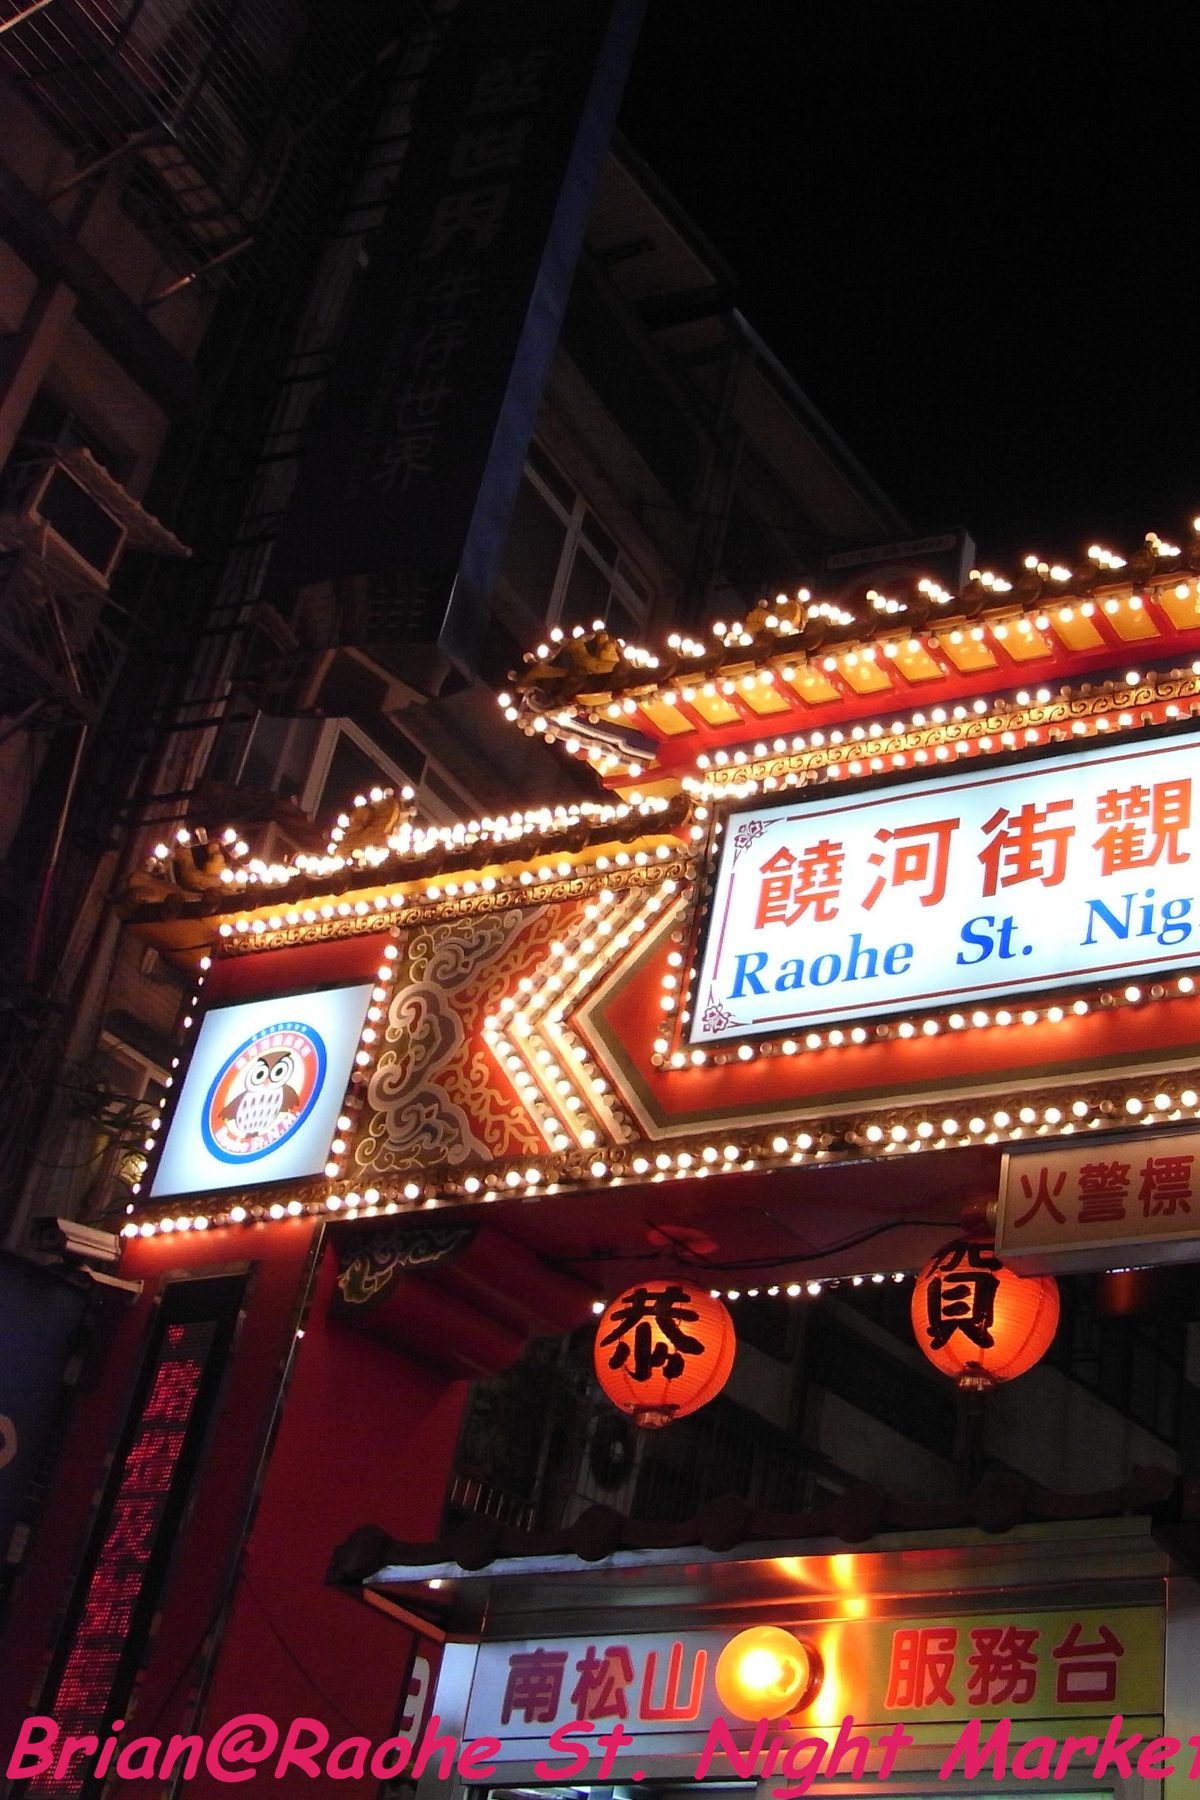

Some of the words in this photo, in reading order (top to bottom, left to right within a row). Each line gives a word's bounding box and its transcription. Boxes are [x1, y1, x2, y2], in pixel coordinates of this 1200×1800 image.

[727, 932, 914, 1000] Raohe
[956, 914, 1033, 966] St.
[600, 1285, 705, 1382] 恭
[924, 1238, 1004, 1351] 賀
[500, 1640, 707, 1725] 南松山
[885, 1621, 1125, 1710] 服務台
